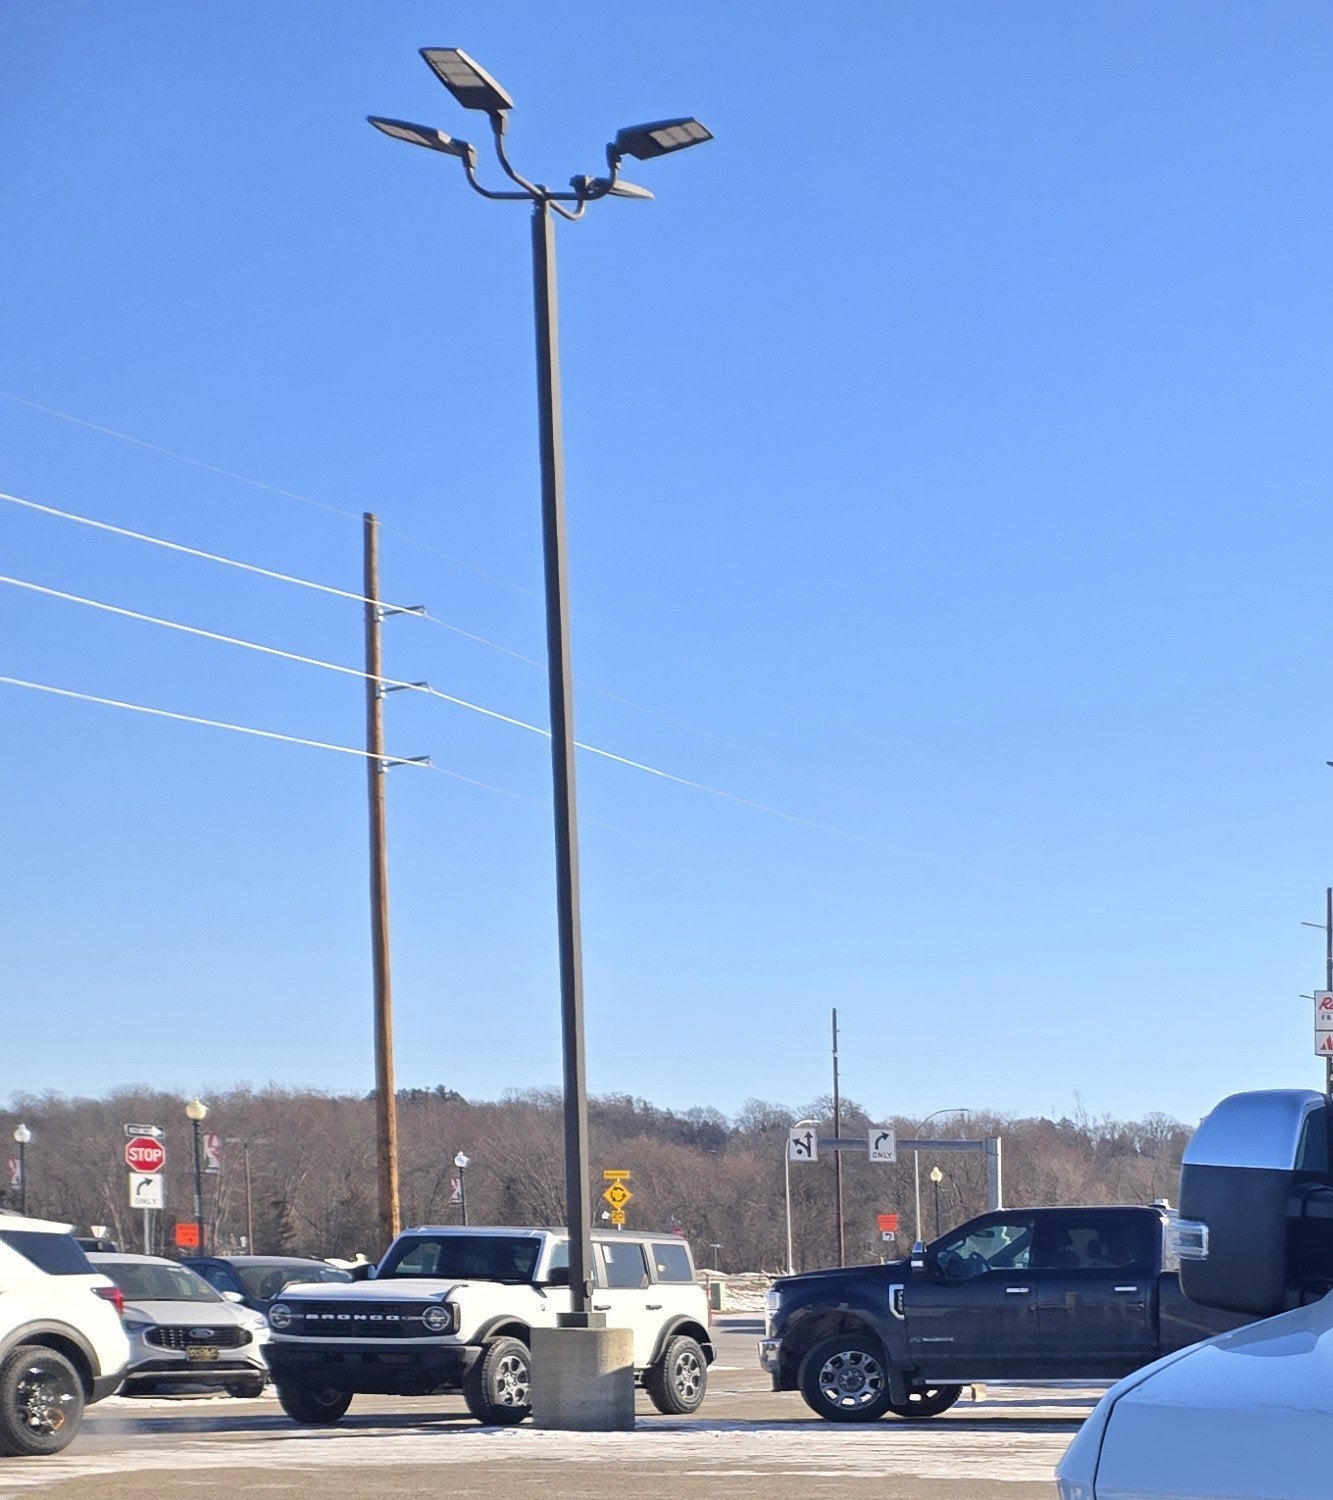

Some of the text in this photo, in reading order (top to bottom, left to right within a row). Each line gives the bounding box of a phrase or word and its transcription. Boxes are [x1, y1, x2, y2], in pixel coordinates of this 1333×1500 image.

[128, 1147, 162, 1163] STOP
[872, 1151, 894, 1160] ONLY
[135, 1197, 157, 1205] ONLY
[612, 1211, 624, 1219] 20
[305, 1313, 400, 1321] BRONCO
